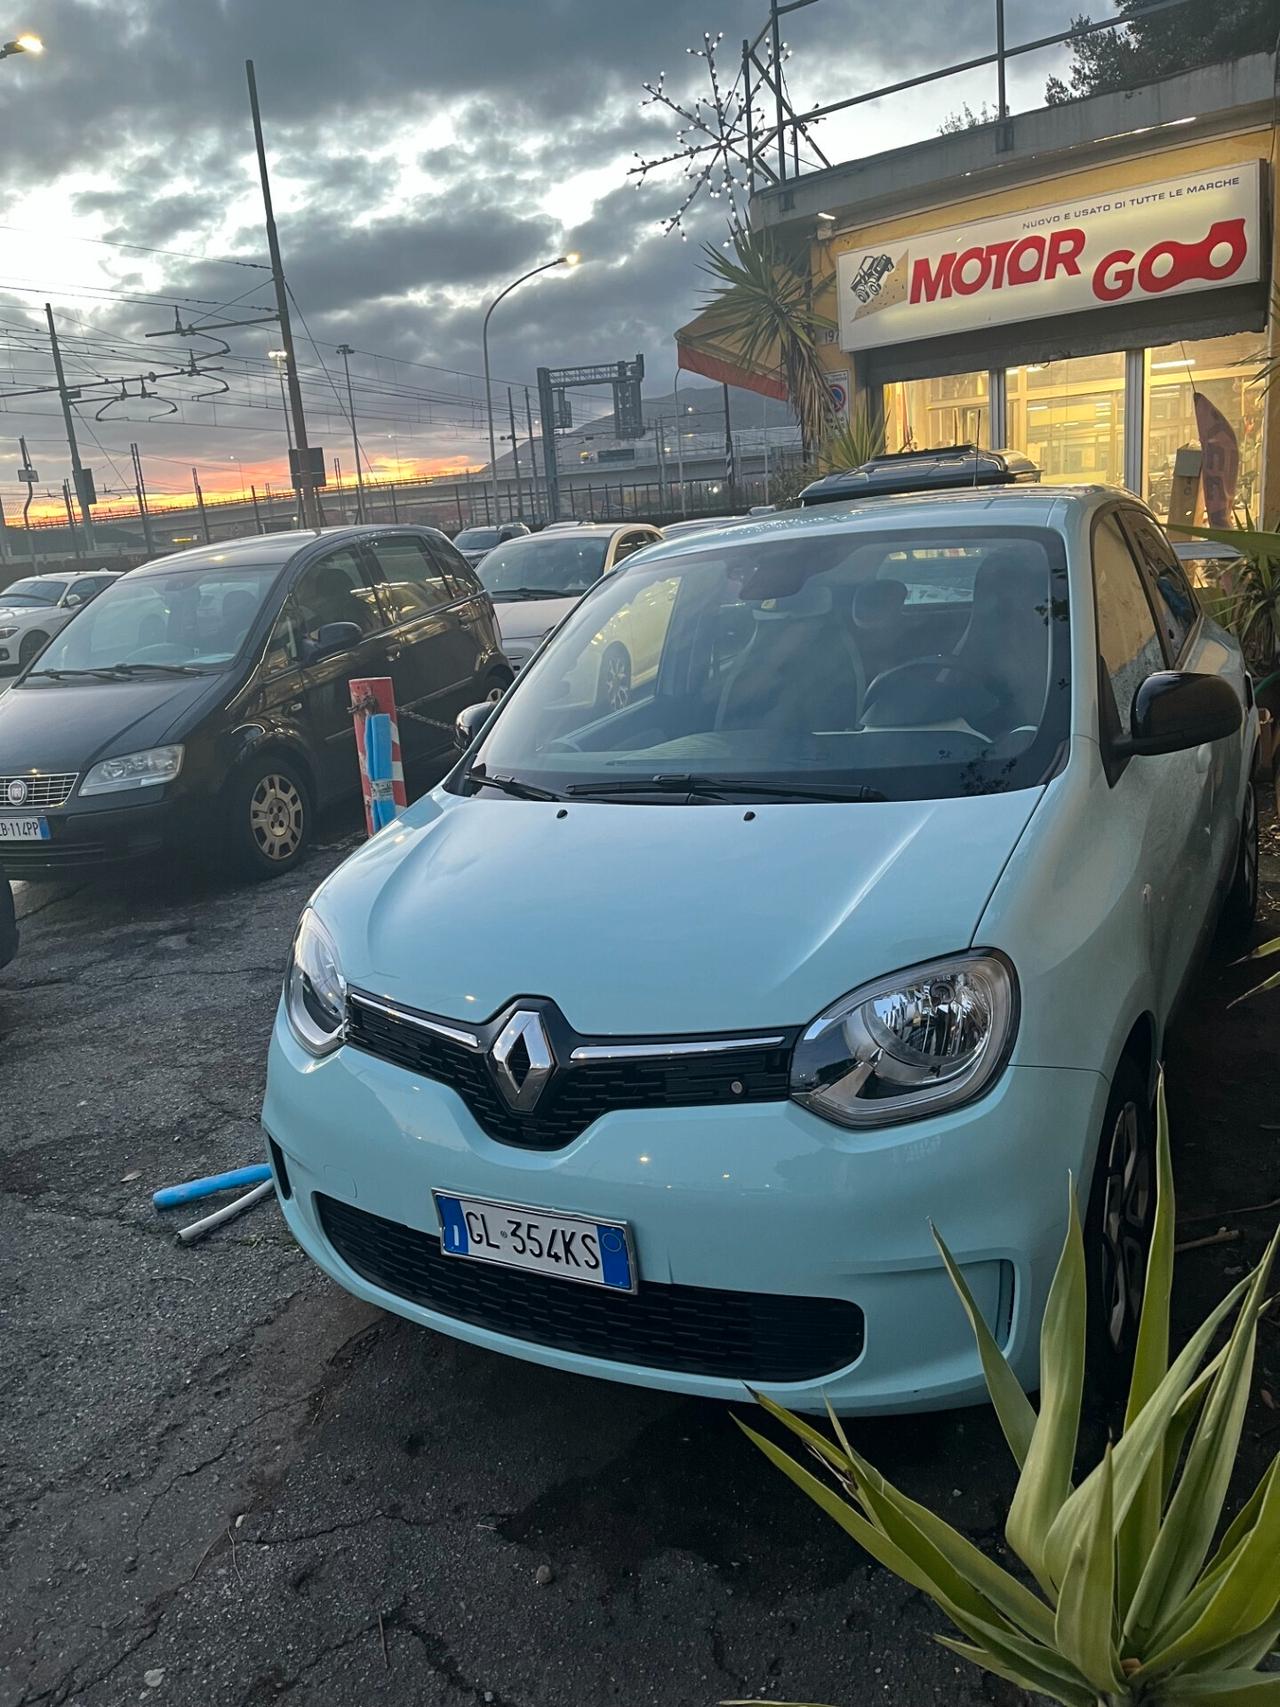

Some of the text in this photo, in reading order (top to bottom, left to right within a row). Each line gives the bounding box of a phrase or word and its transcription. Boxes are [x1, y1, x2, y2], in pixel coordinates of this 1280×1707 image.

[1022, 177, 1240, 230] NUOVO E USATO DI TUTTE LE MARCHE
[910, 228, 1086, 304] MOTOR
